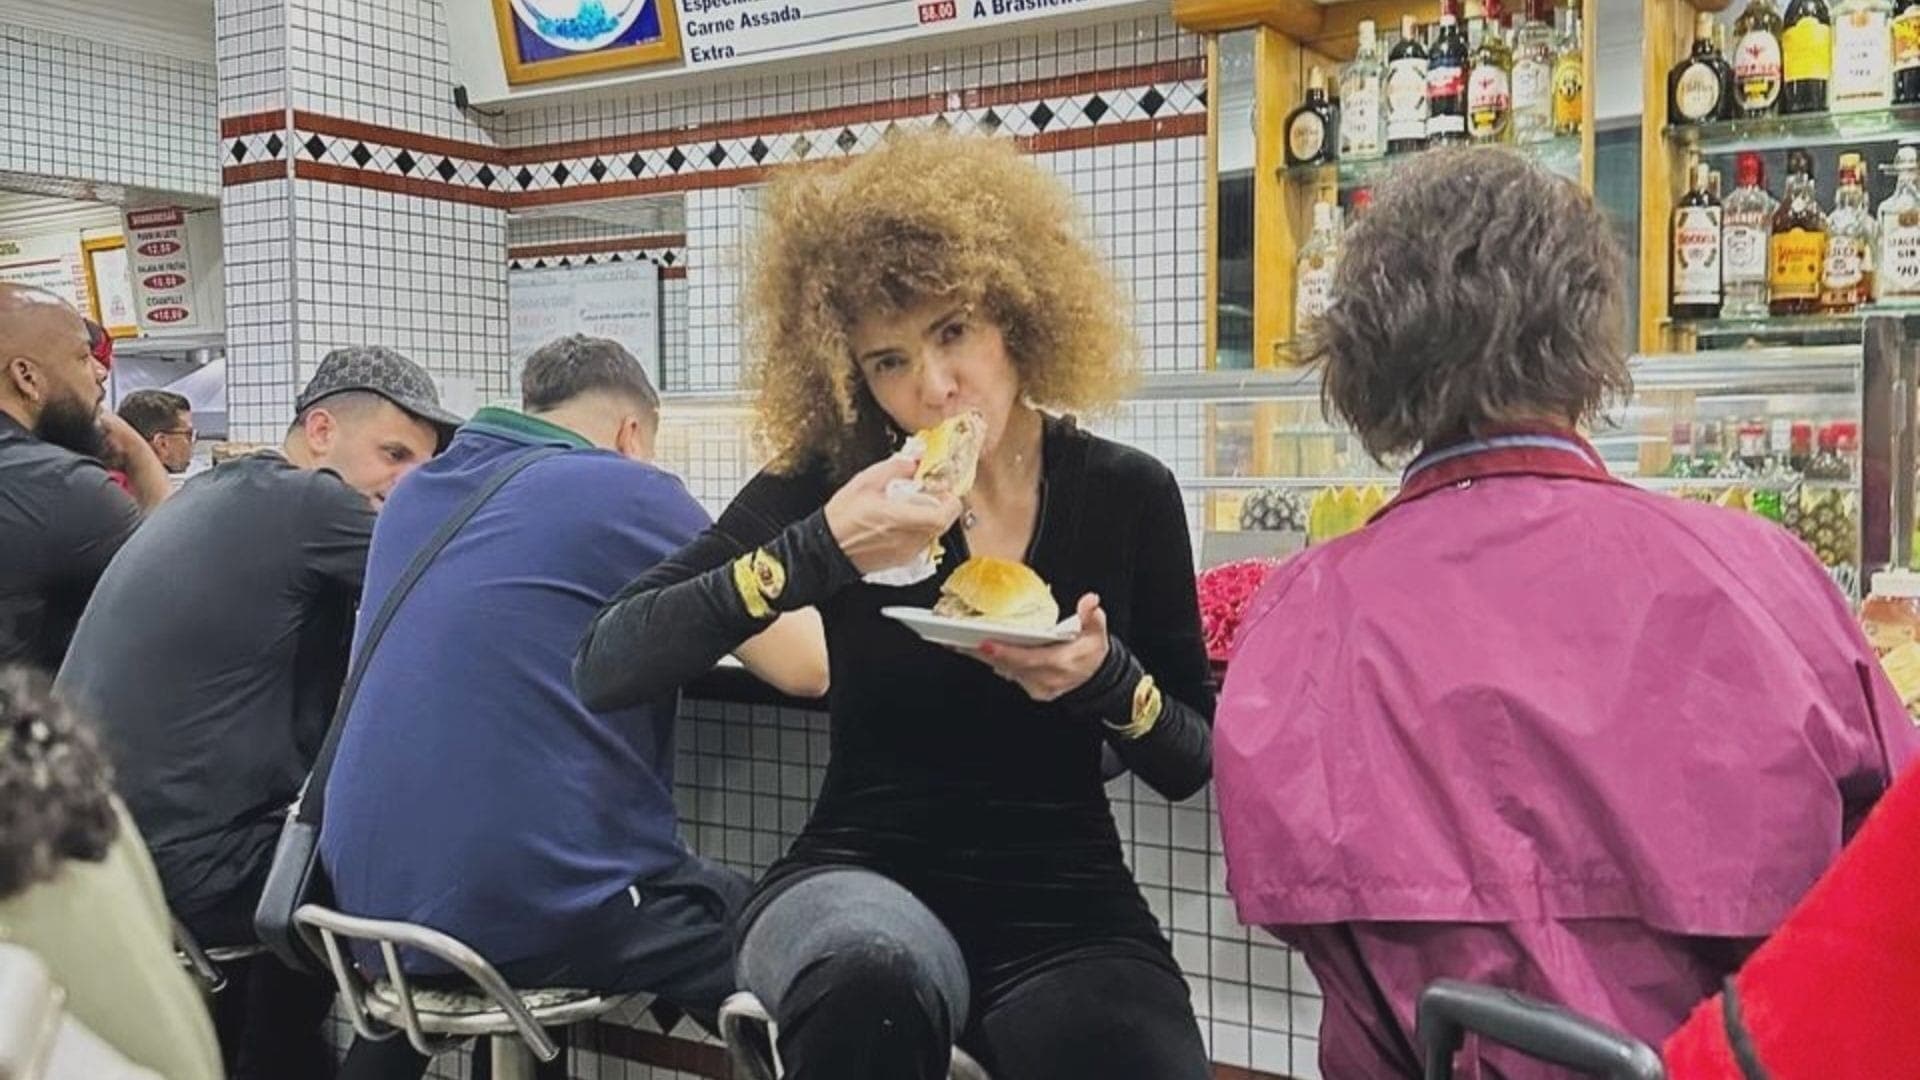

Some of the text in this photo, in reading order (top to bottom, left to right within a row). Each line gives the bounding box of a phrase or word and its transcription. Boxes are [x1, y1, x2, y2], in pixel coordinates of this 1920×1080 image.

[973, 0, 1087, 18] A Brasil
[687, 5, 801, 36] Carne Assada
[691, 45, 735, 62] Extra
